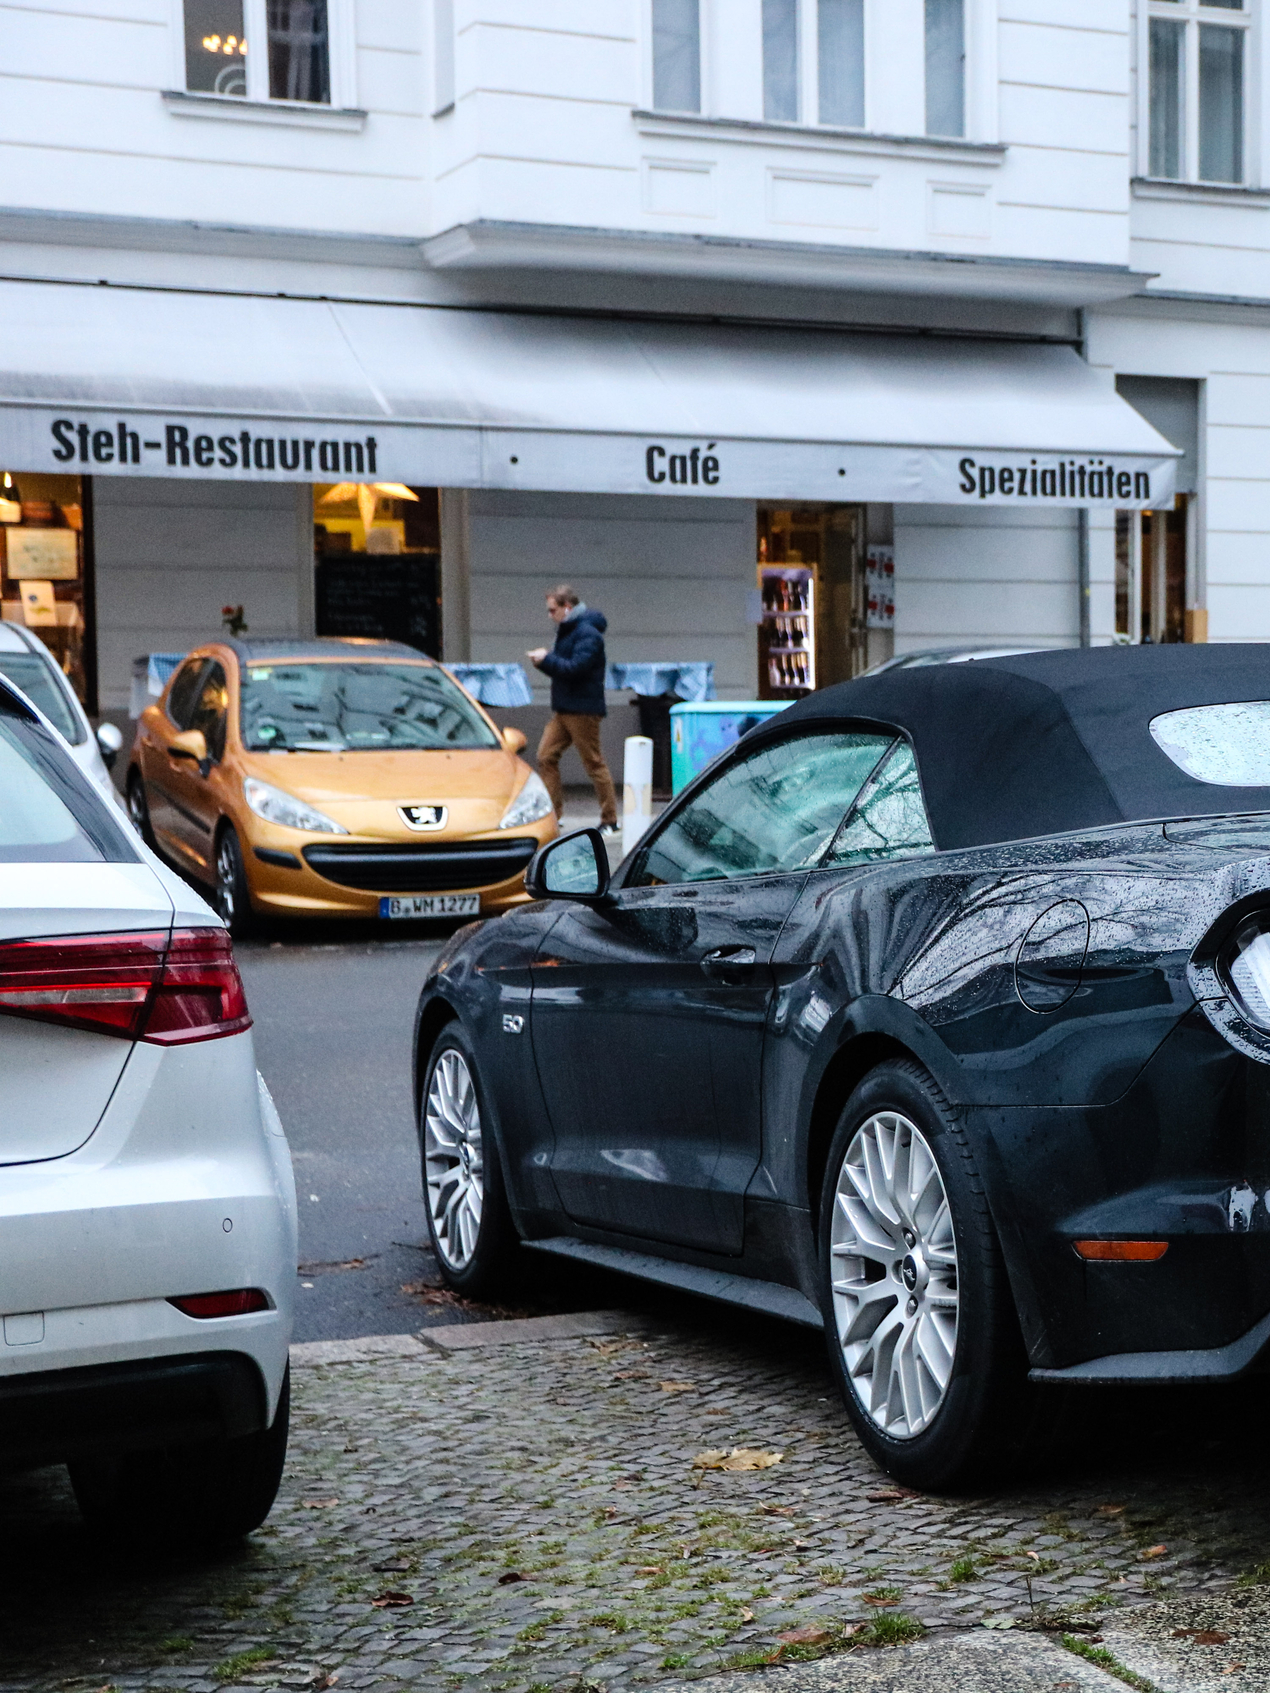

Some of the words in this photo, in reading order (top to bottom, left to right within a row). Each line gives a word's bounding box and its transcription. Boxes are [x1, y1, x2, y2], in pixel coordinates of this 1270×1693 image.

[51, 420, 377, 474] Steh-Restaurant
[646, 443, 719, 485] Café
[959, 457, 1149, 499] Spezialitäten
[438, 896, 477, 913] 1277
